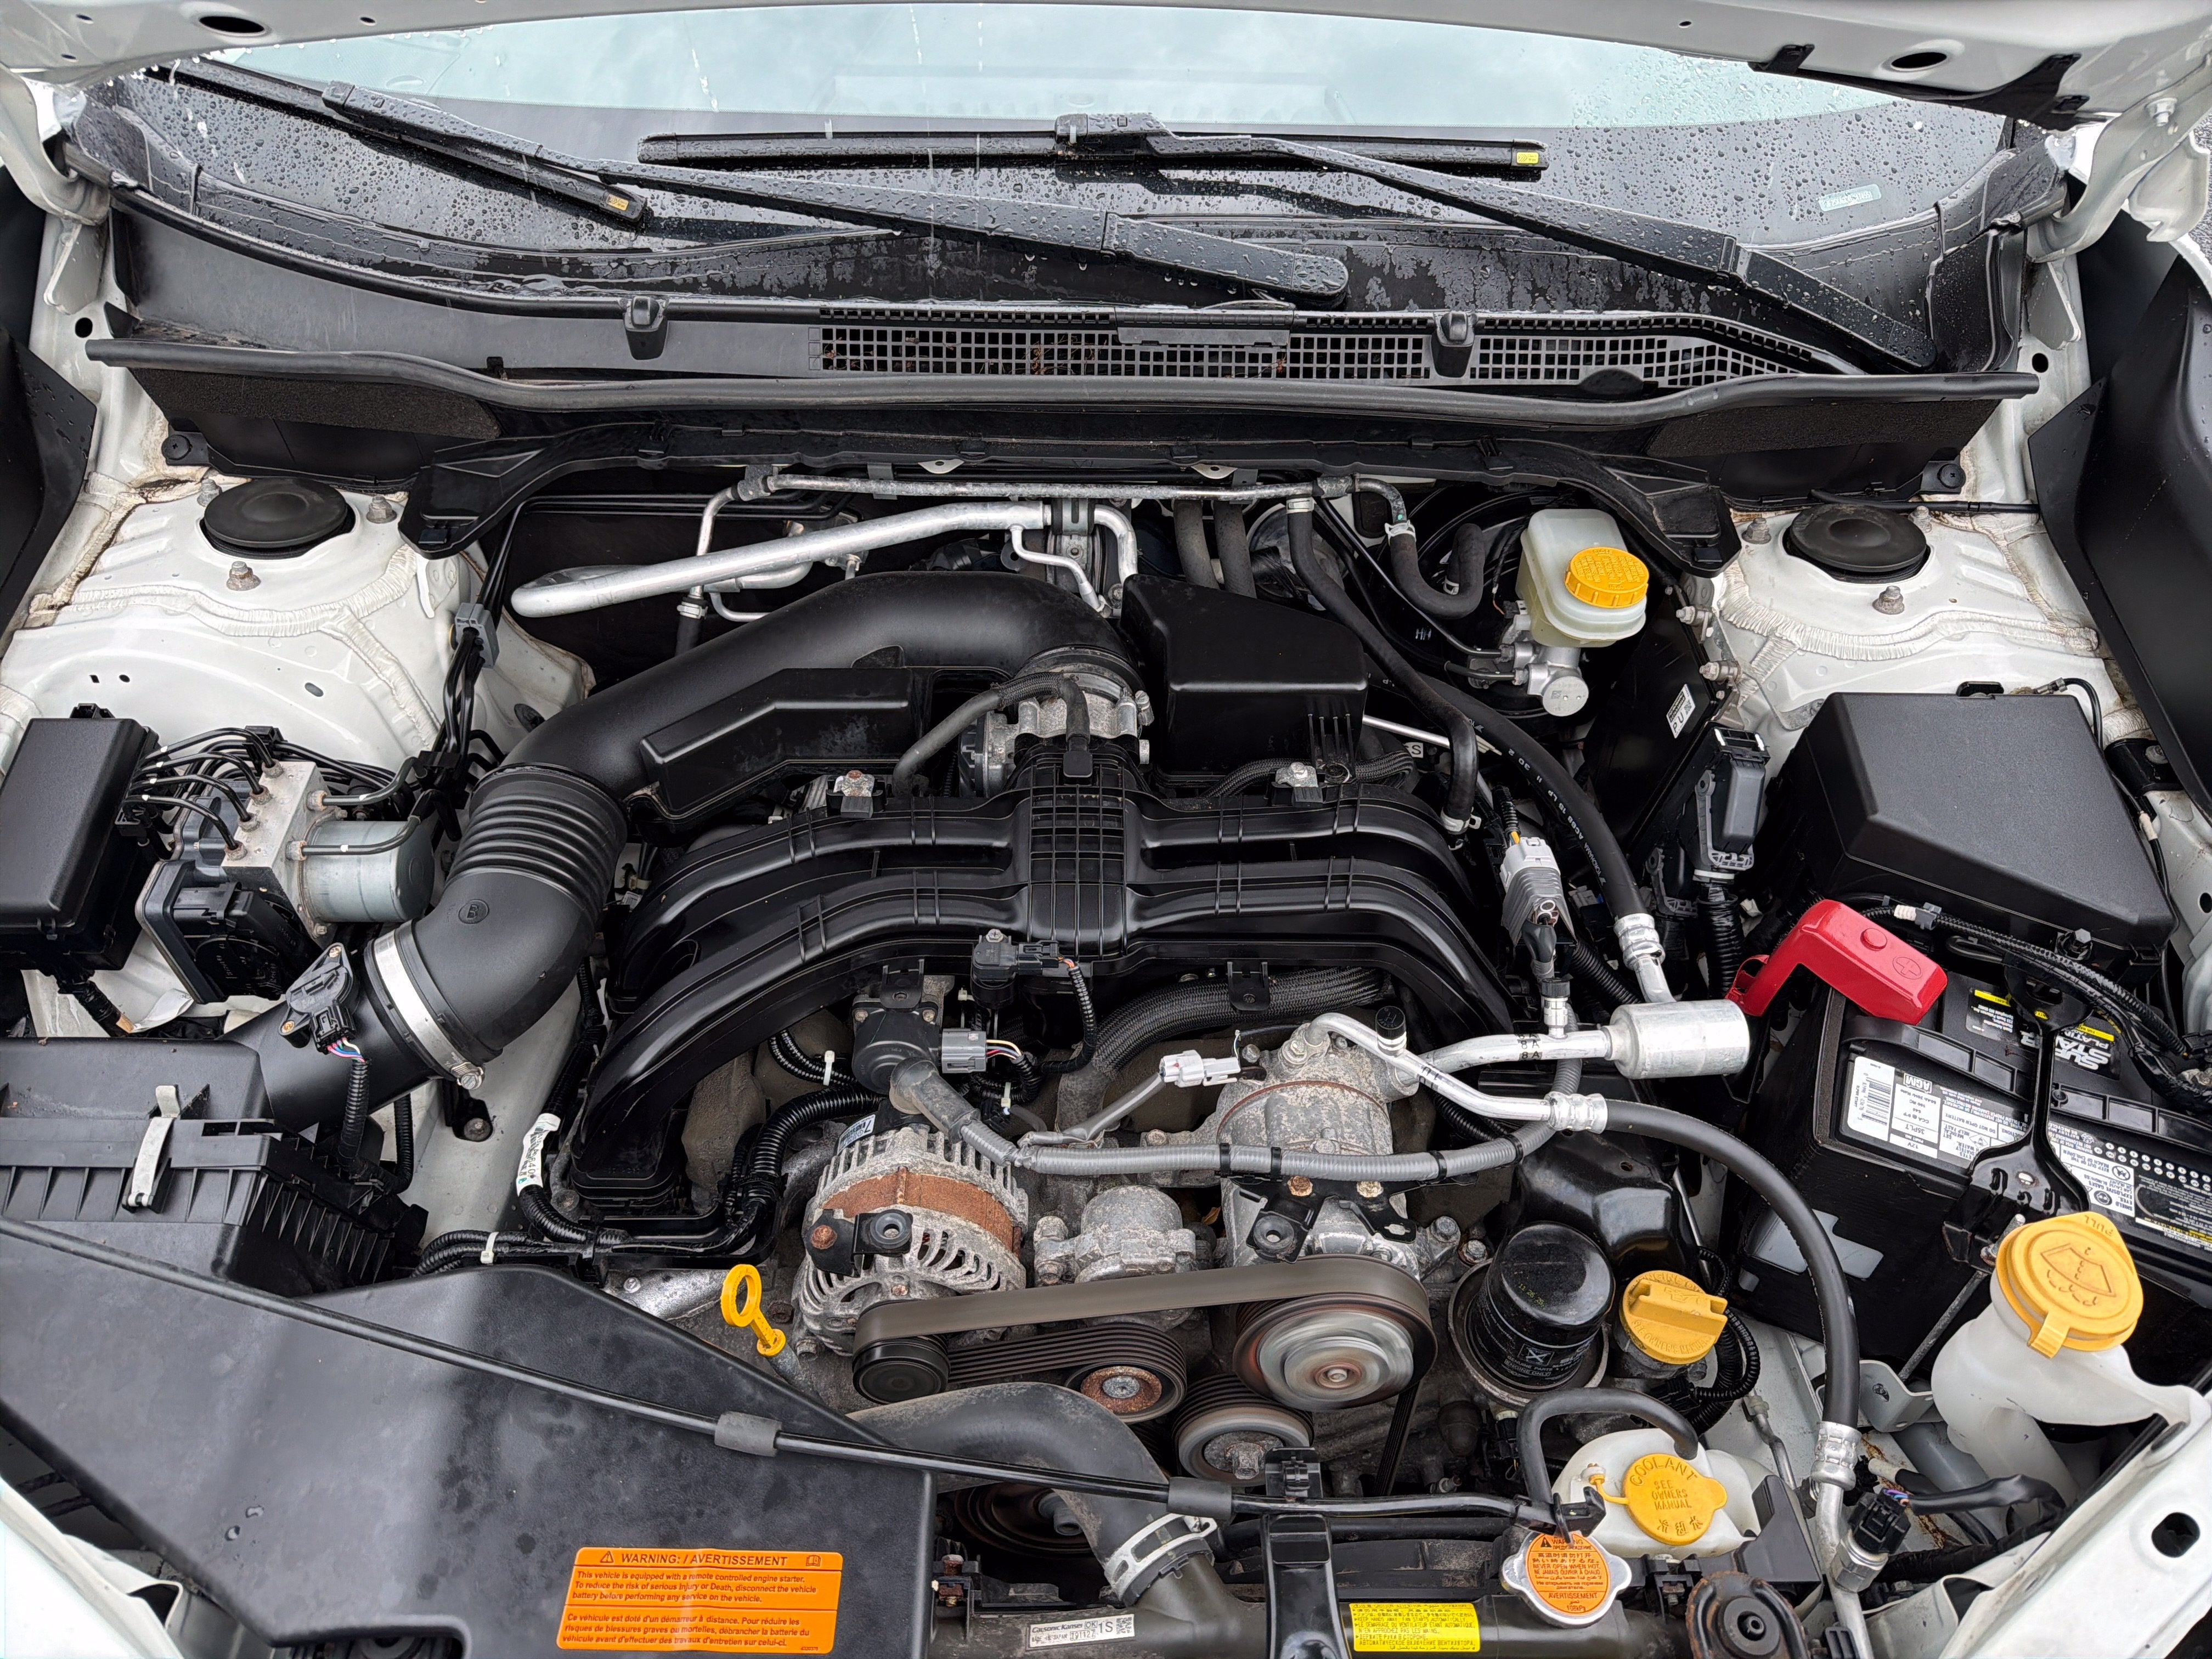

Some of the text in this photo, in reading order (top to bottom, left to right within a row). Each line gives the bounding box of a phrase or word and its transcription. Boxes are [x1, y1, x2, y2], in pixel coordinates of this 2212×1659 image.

[1548, 790, 1558, 802] LP
[1558, 803, 1567, 814] 15
[1584, 843, 1602, 877] YOKOHAMA
[1905, 1075, 1929, 1090] AGM
[1905, 1123, 1925, 1135] 35PLT
[2115, 1201, 2132, 1211] SHIELD
[2084, 1215, 2114, 1235] PULL
[1629, 1457, 1698, 1486] COOLANT
[1654, 1480, 1673, 1489] SEE
[1651, 1488, 1688, 1501] OWNERS
[1654, 1498, 1692, 1510] MANUAL
[622, 1553, 681, 1564] WARNING:
[690, 1554, 788, 1566] AVERTISSEMENT
[630, 1572, 664, 1581] equipped
[753, 1575, 778, 1583] engine
[710, 1583, 733, 1592] Death,
[572, 1592, 599, 1600] battery
[624, 1592, 665, 1601] performing
[706, 1616, 740, 1624] distance.
[741, 1617, 760, 1625] Pour
[761, 1617, 787, 1625] réduire
[789, 1617, 800, 1626] les
[565, 1624, 592, 1633] risques
[681, 1626, 717, 1634] mortelles,
[719, 1627, 760, 1635] débrancher
[769, 1628, 798, 1636] batterie
[1032, 1625, 1061, 1633] Calsonic
[1098, 1621, 1114, 1634] 1S
[618, 1635, 658, 1644] d'effectuer
[703, 1637, 742, 1645] d'entretien
[758, 1639, 787, 1647] celui-ci.
